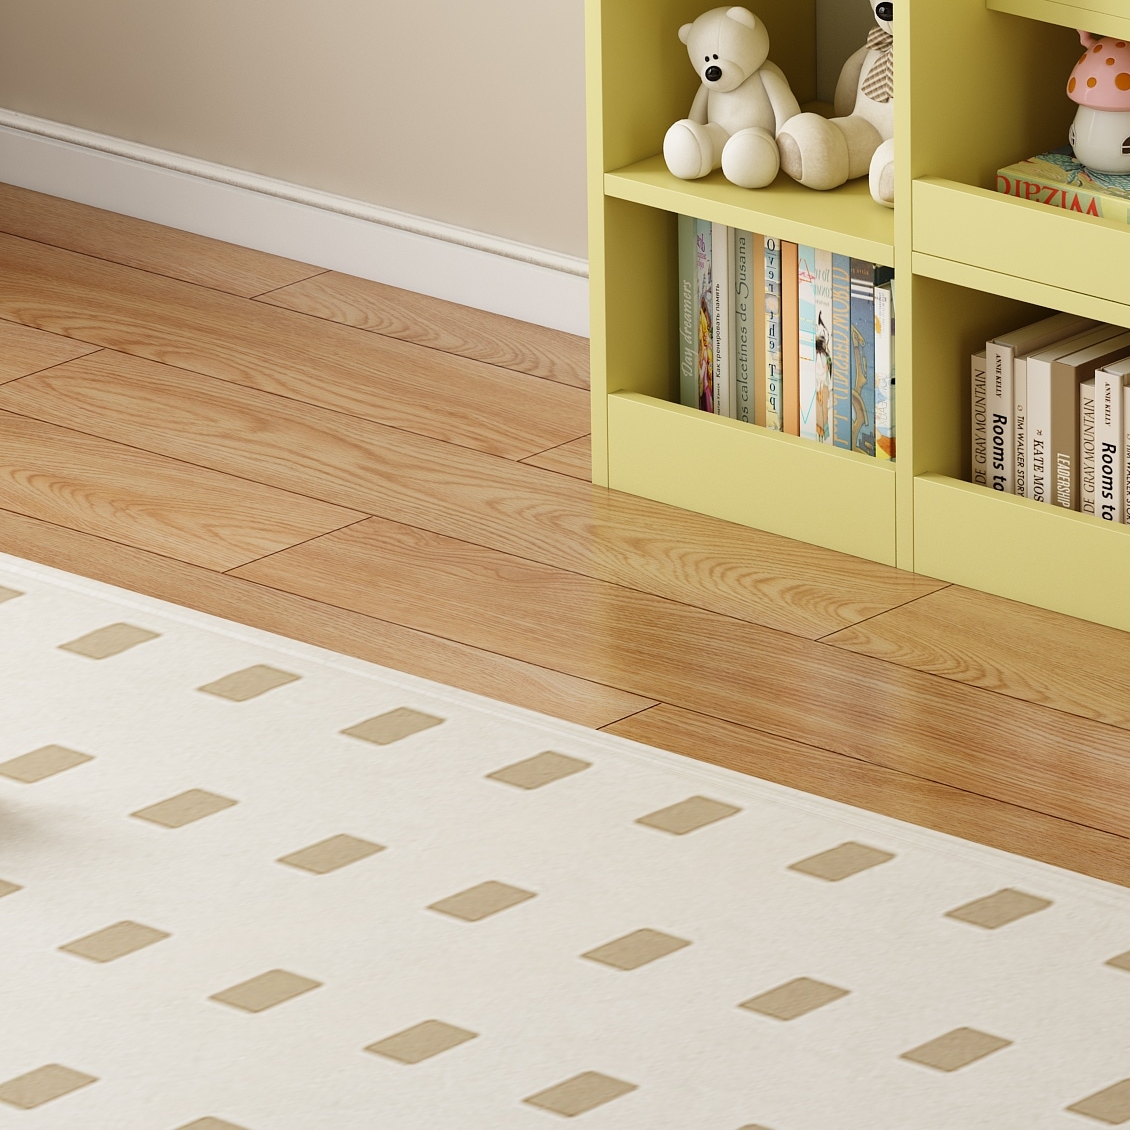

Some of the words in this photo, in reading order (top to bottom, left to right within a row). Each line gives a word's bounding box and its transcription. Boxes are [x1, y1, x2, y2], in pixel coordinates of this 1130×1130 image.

[736, 237, 750, 300] Susana
[680, 280, 692, 345] dreamers
[736, 302, 747, 318] de
[681, 351, 698, 378] Day
[736, 326, 748, 401] calcetines
[974, 369, 986, 432] MOUNTAIN
[1104, 382, 1112, 404] ANNIE
[1084, 398, 1095, 461] MOUNTAIN
[1104, 404, 1112, 427] KELLY
[974, 433, 986, 464] GRAY
[993, 413, 1008, 470] Rooms
[1034, 439, 1044, 473] KATE
[993, 476, 1006, 492] to
[1057, 452, 1070, 508] LEADERSHIP
[1084, 464, 1095, 493] GRAY
[1102, 442, 1116, 500] Rooms
[1034, 475, 1044, 502] MOS
[1102, 505, 1116, 521] to
